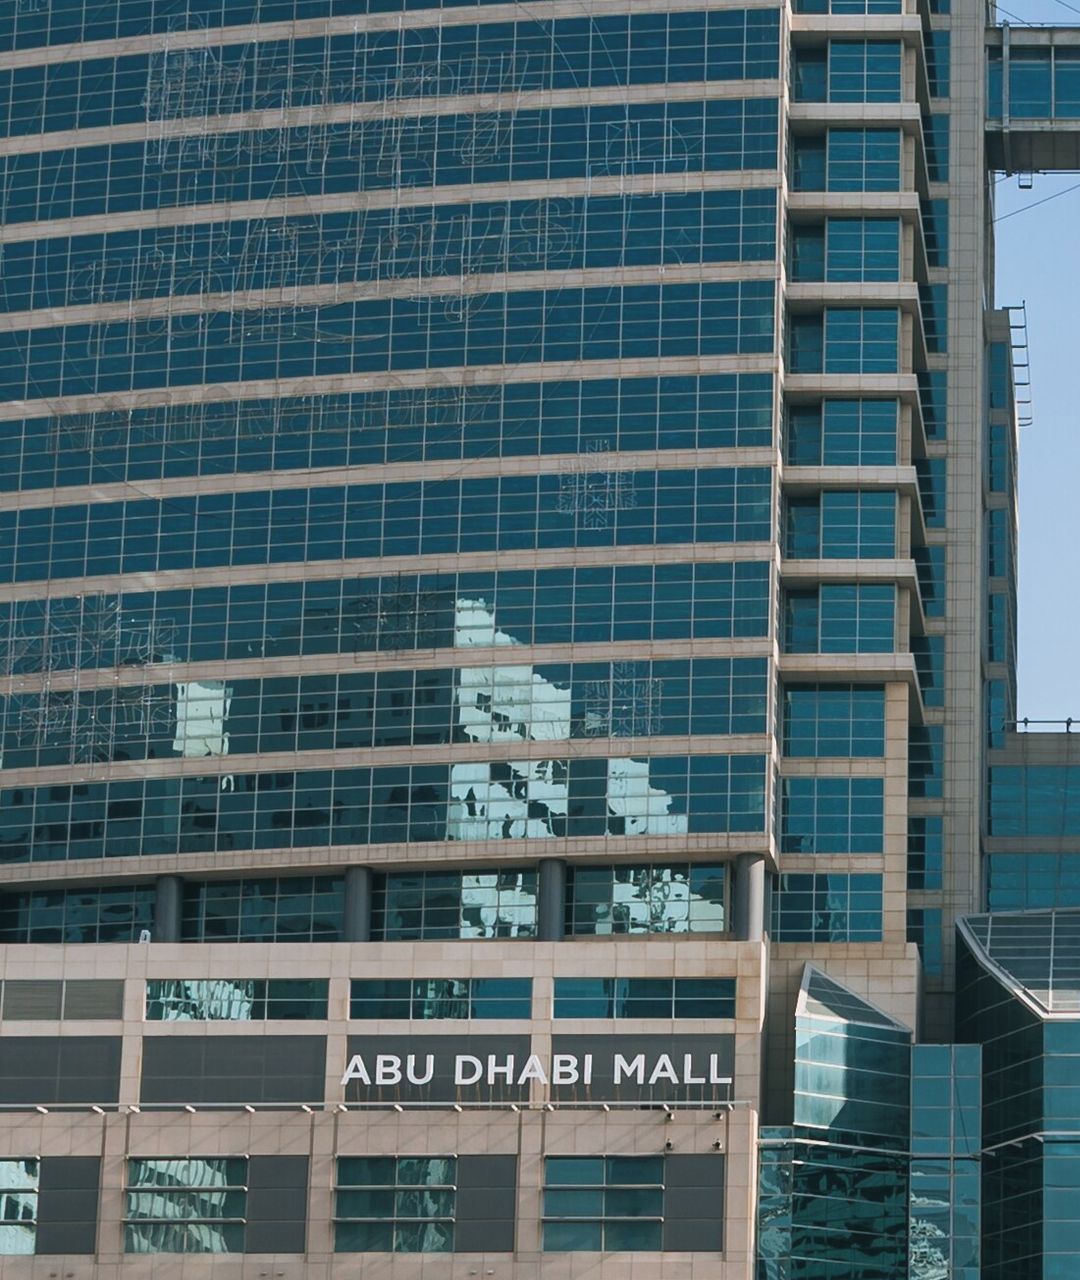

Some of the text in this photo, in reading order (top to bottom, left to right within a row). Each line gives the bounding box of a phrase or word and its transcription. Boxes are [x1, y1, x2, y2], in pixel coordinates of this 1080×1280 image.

[341, 1053, 733, 1085] ABU DHABI MALL
